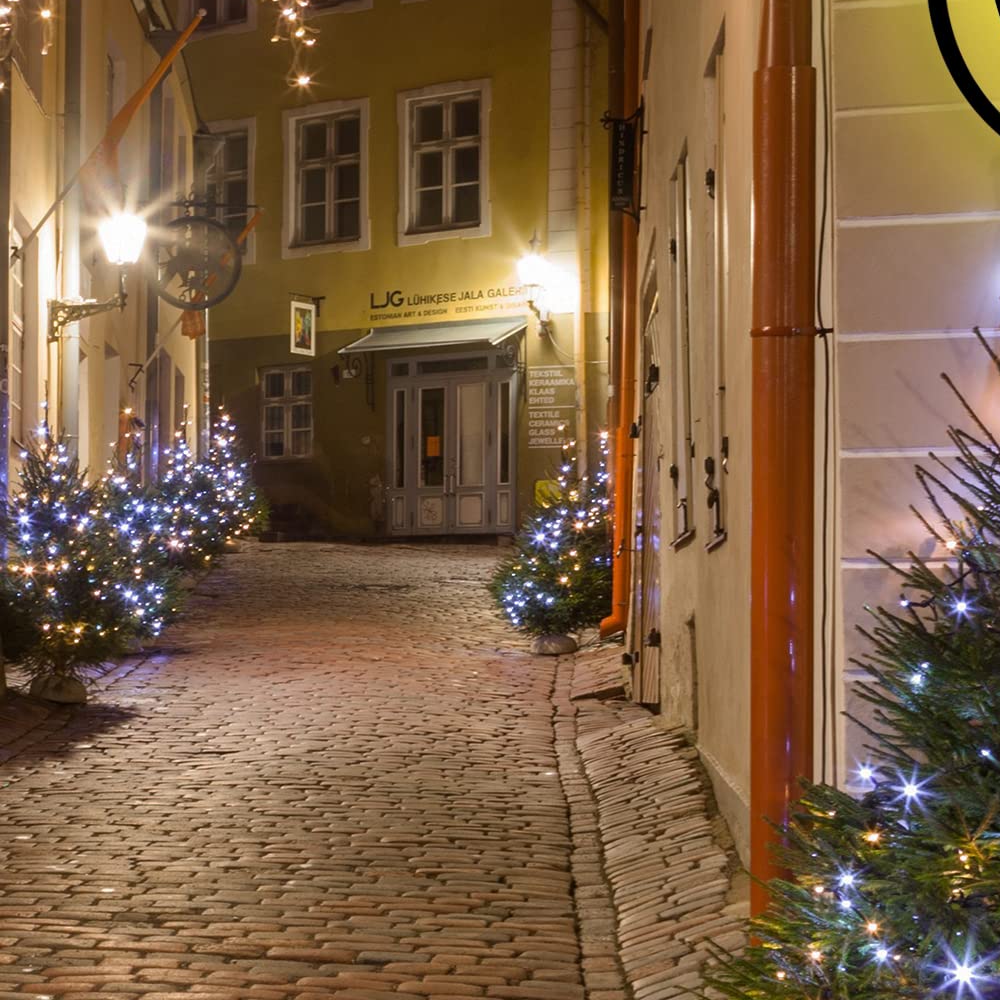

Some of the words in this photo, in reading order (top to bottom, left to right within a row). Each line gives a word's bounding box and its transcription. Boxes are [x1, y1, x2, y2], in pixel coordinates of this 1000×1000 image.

[370, 291, 404, 309] LJG
[407, 293, 457, 306] LÜHIKESE
[457, 290, 484, 301] JALA
[403, 310, 416, 319] ART
[423, 308, 448, 318] DESIGN
[528, 411, 560, 419] TEXTILE
[528, 429, 556, 437] GLASS
